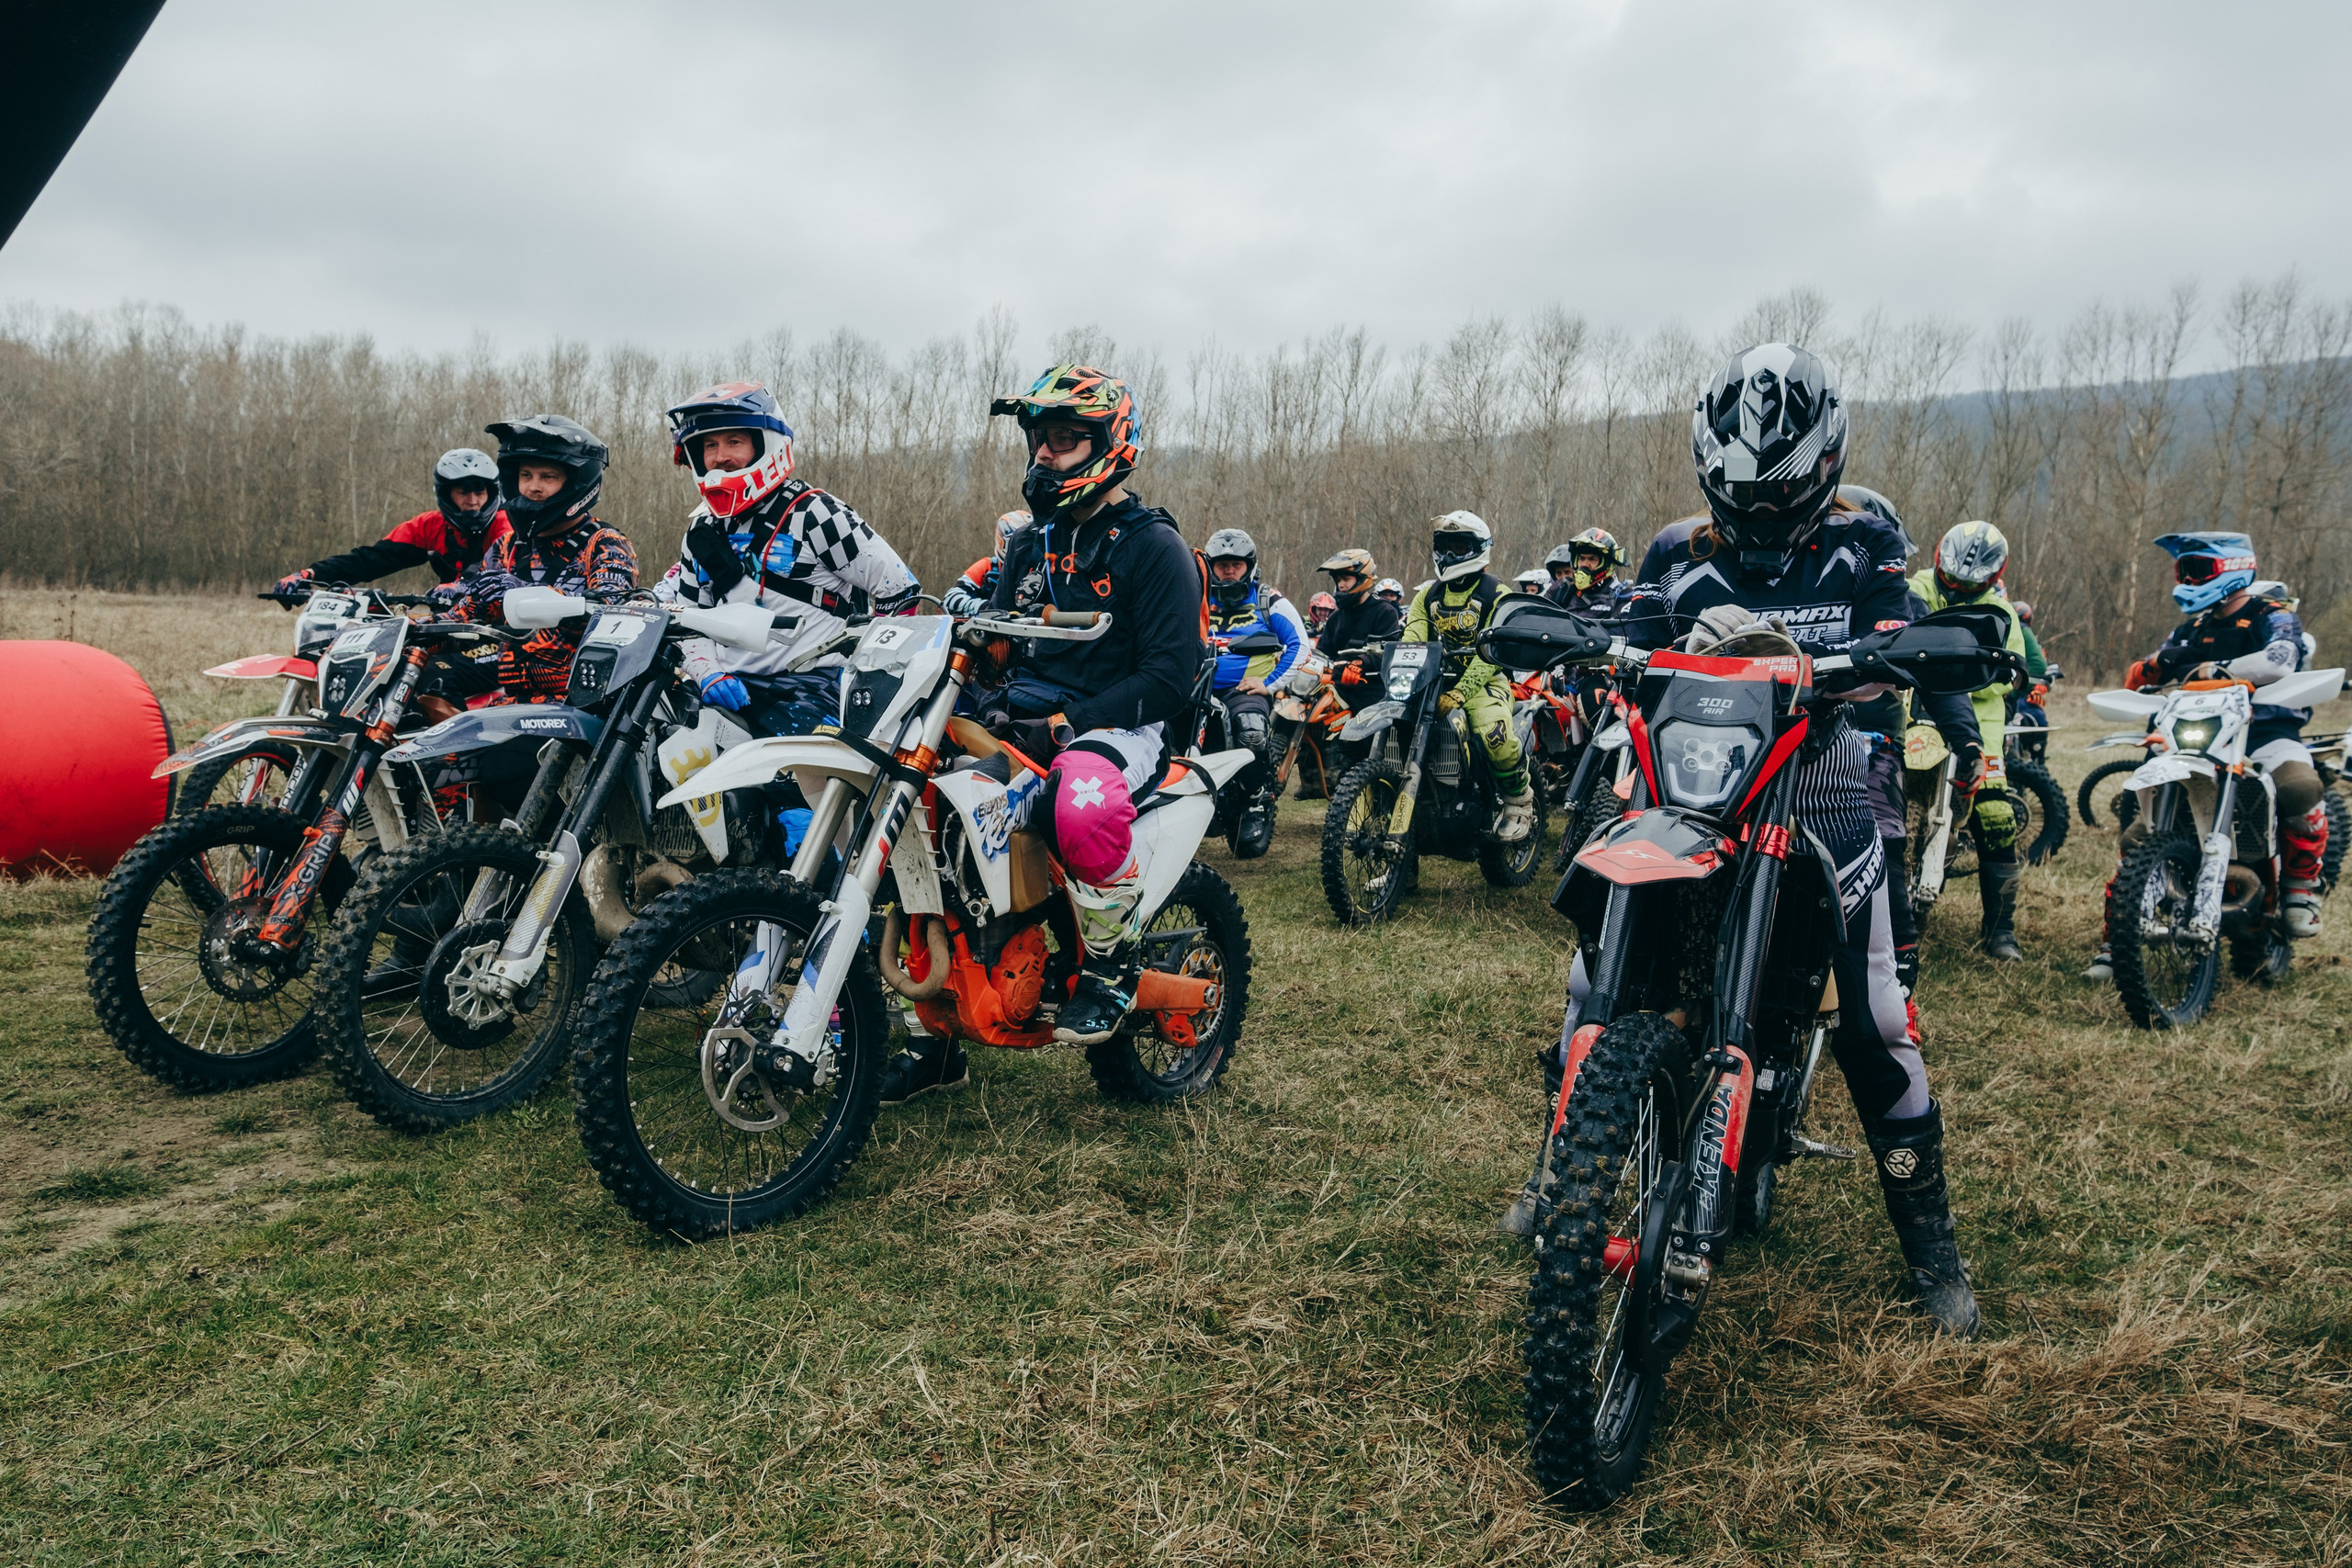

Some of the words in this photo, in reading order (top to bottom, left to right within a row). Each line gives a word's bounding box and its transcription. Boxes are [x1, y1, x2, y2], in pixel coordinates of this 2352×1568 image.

[316, 601, 338, 612] 184
[610, 620, 622, 635] 1
[343, 632, 366, 645] 111
[875, 628, 898, 645] 13
[1401, 651, 1418, 660] 53
[1769, 664, 1797, 672] PRO
[393, 682, 410, 703] SES
[1697, 697, 1735, 709] 300
[1702, 706, 1724, 716] AIR
[520, 718, 568, 729] MOTOREX
[283, 833, 333, 903] X-GRIP
[1841, 829, 1884, 915] SHAR
[565, 999, 580, 1031] GRIP
[1692, 1082, 1735, 1198] KENDA
